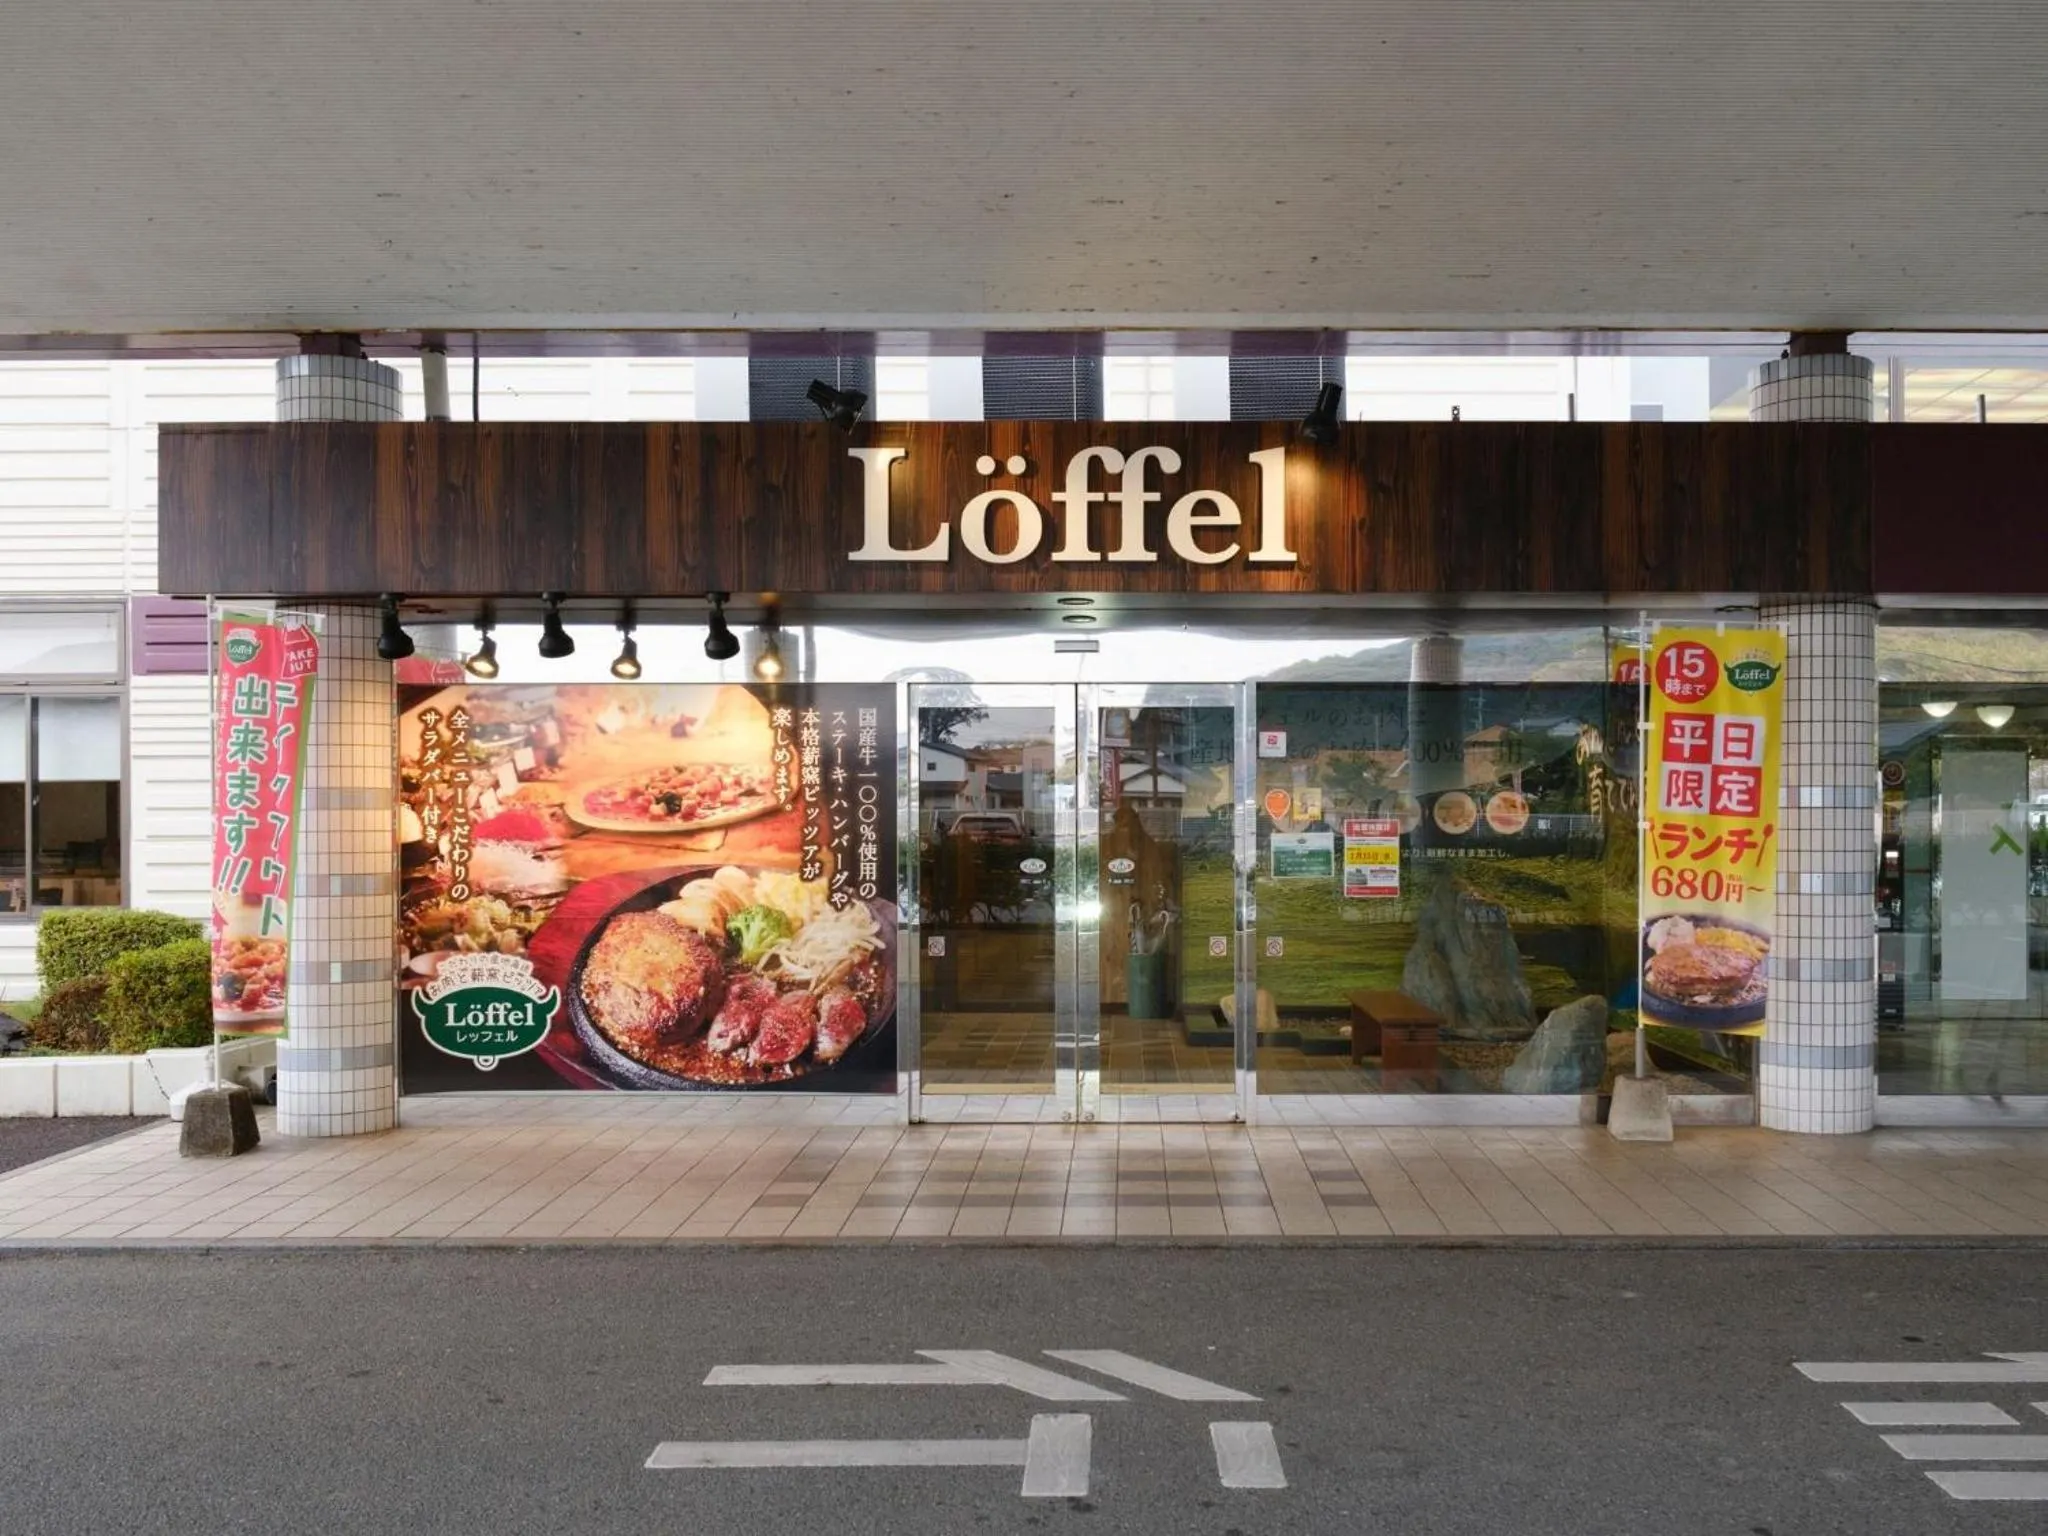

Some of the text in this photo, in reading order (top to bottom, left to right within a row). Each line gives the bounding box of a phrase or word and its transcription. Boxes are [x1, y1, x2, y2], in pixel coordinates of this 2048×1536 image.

[848, 446, 1297, 564] Löffel
[1665, 647, 1705, 678] 15
[1665, 678, 1706, 697] 時まで
[1668, 718, 1756, 761] 平日
[421, 711, 440, 844] サラダバー付き
[1664, 769, 1756, 812] 限定
[451, 711, 470, 901] 全メニューこだわりの
[1658, 822, 1758, 864] ランチ
[444, 1002, 536, 1027] Löffel
[456, 1030, 518, 1043] レッフェル
